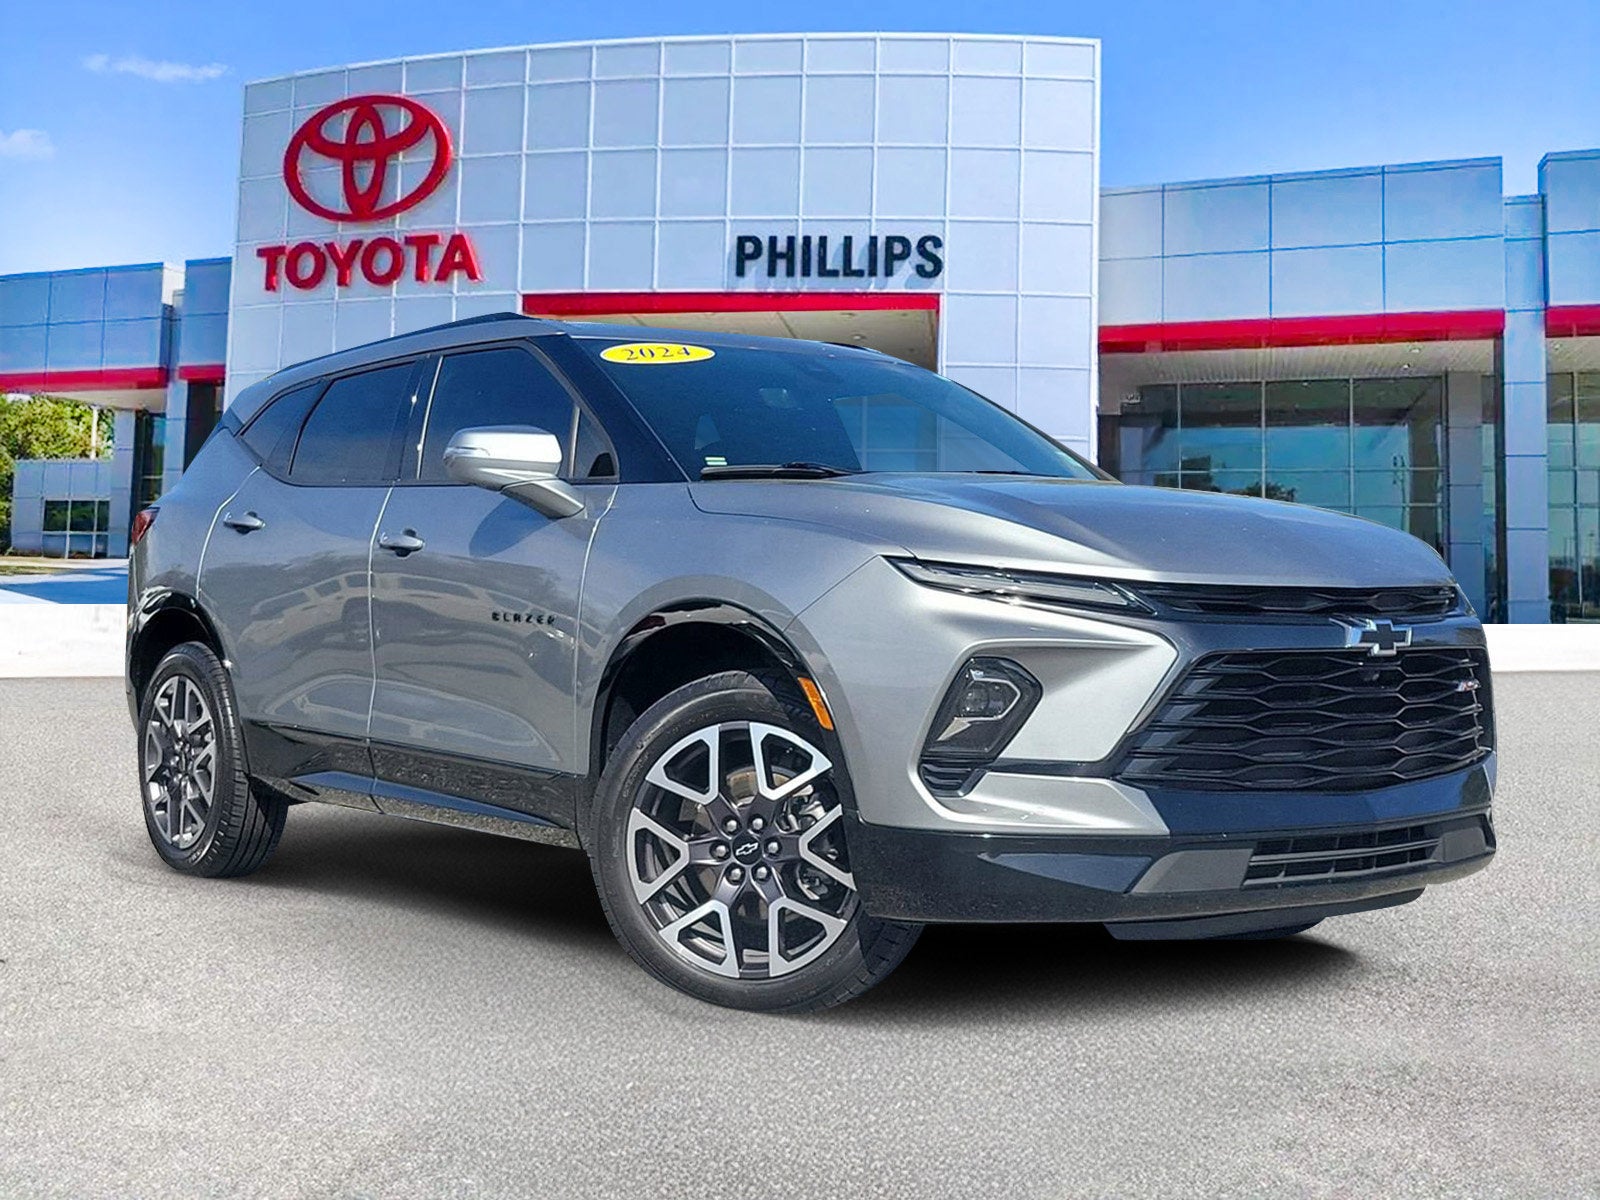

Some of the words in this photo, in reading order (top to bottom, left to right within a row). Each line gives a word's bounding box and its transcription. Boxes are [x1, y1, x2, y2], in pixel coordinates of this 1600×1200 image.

[257, 234, 483, 291] TOYOTA
[736, 235, 943, 278] PHILLIPS
[621, 346, 690, 361] 2024
[491, 611, 556, 625] BLAZER
